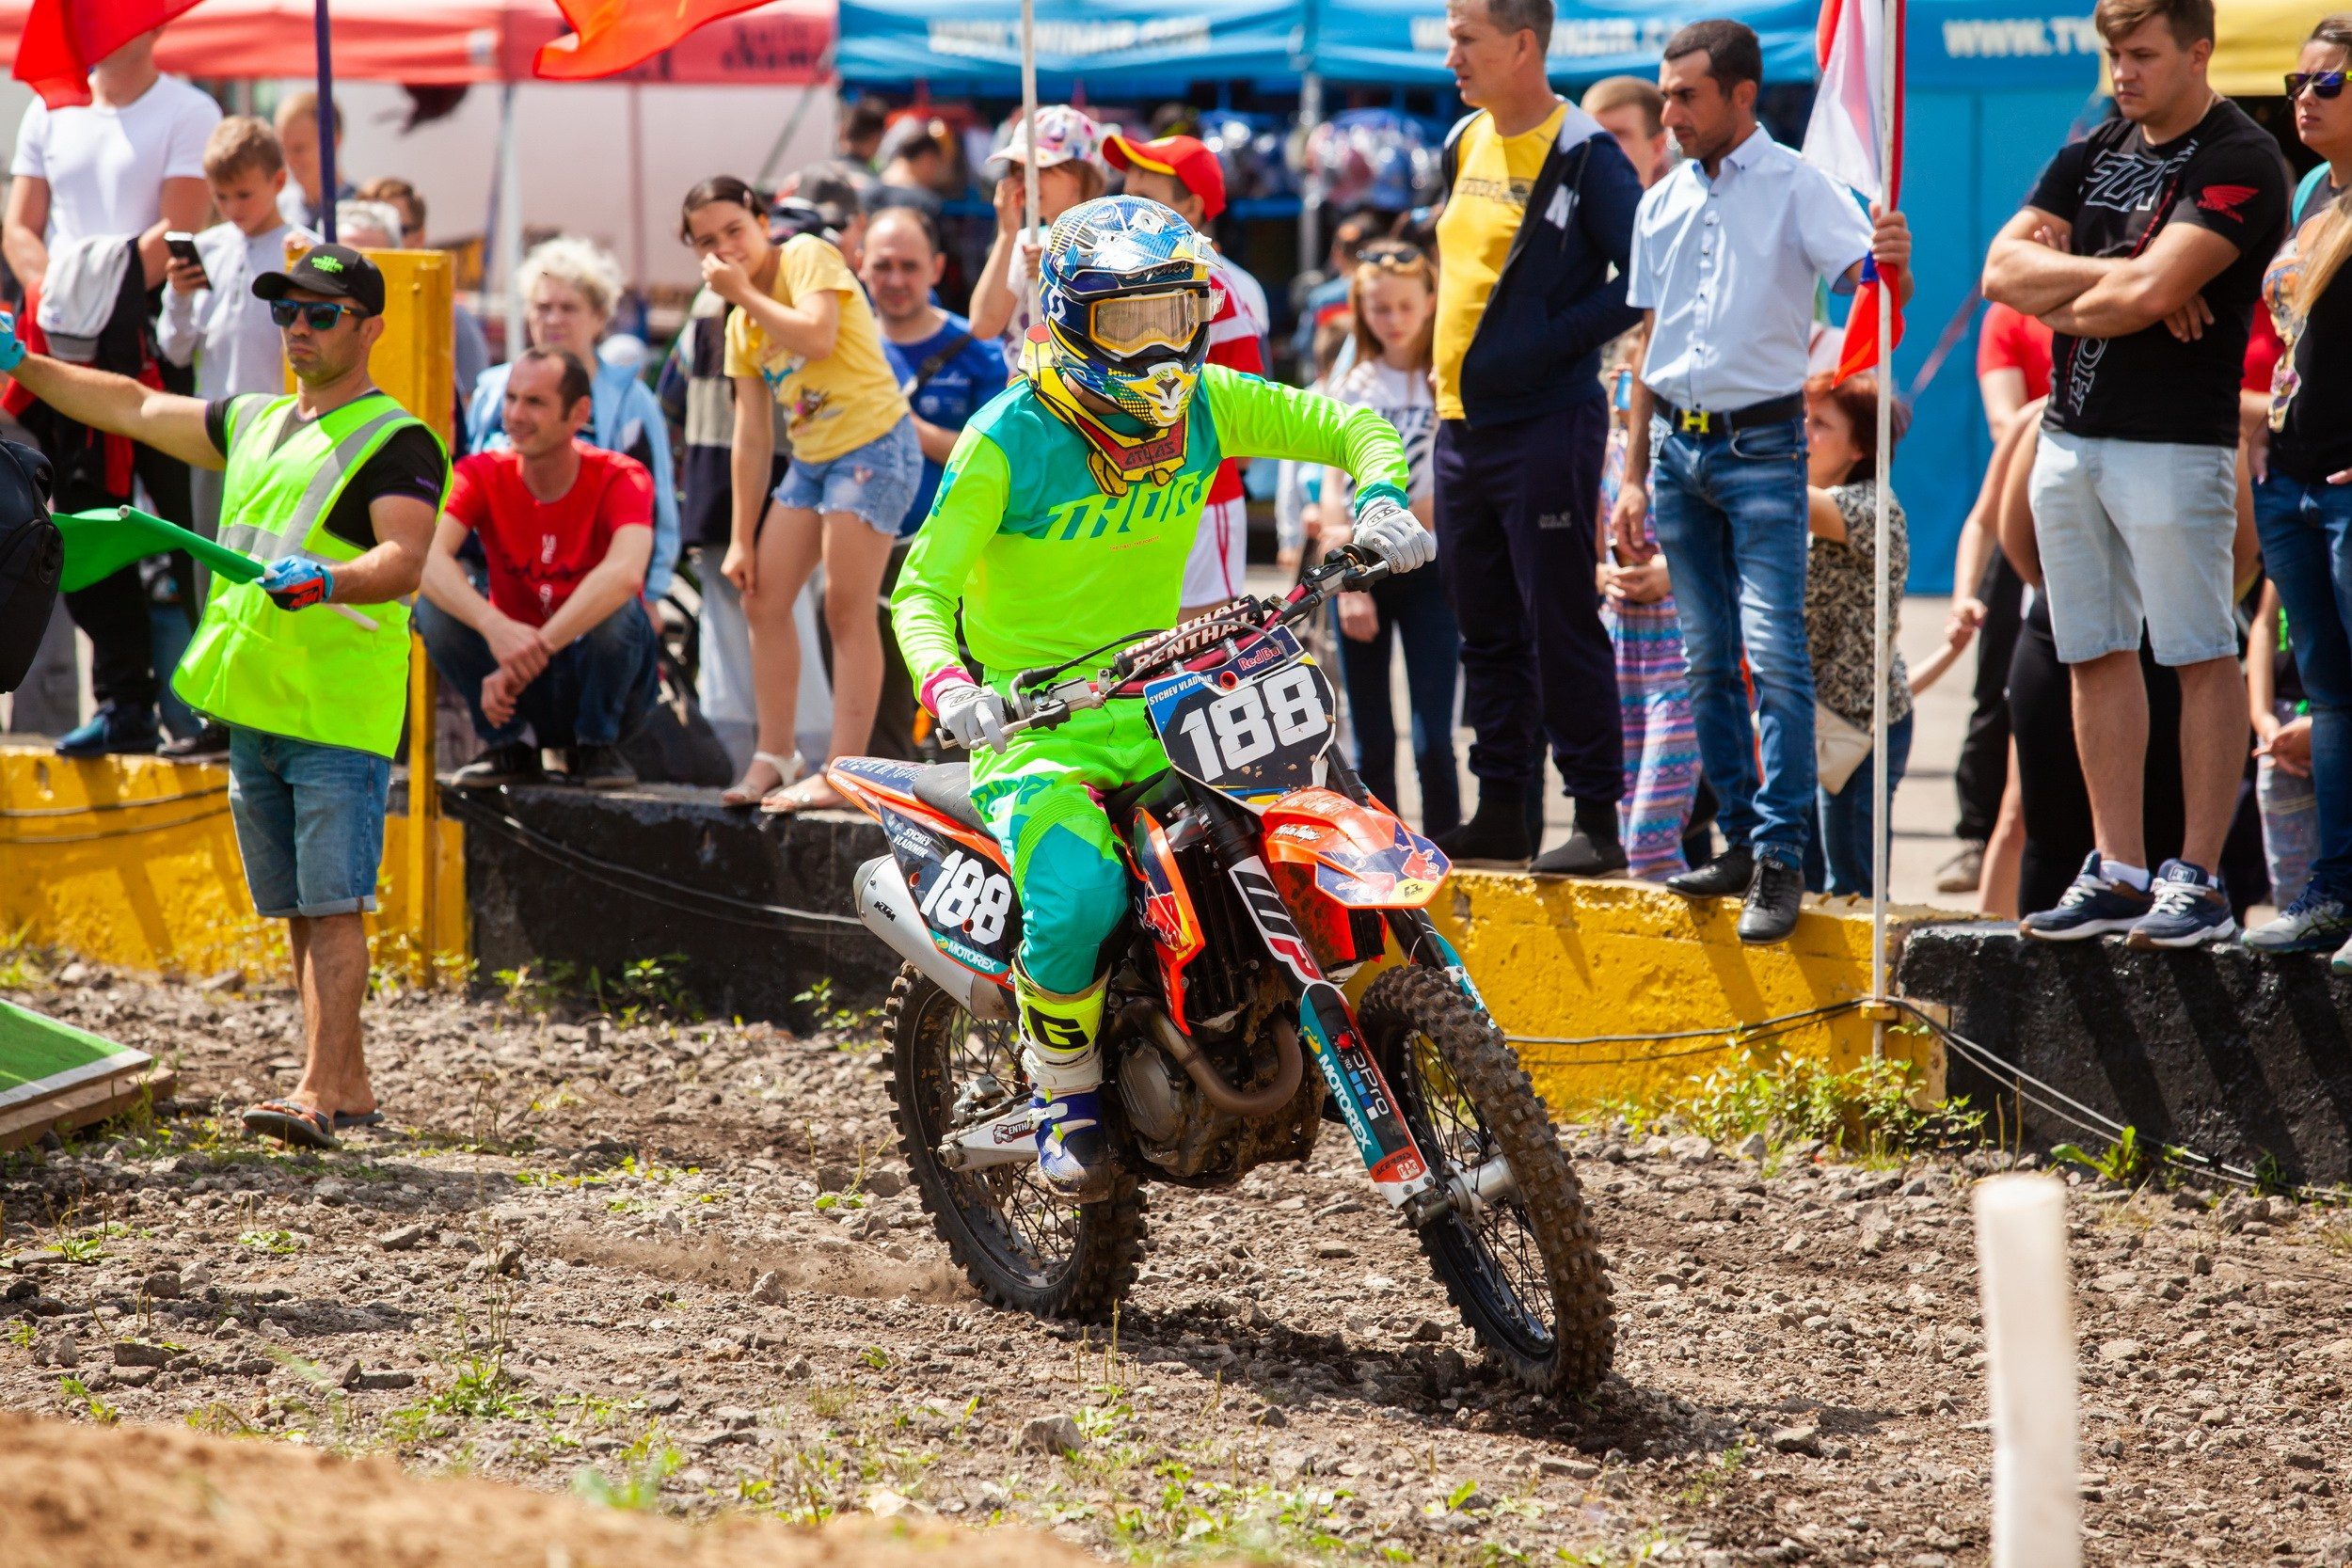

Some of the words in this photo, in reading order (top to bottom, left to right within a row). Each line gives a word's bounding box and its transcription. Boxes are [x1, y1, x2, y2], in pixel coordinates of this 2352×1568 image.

[1942, 16, 2100, 58] WWW.TW
[1124, 440, 1176, 466] ATLAS
[1124, 599, 1249, 657] RENTHAL
[1238, 649, 1263, 672] Red
[1149, 685, 1178, 706] SYCHEV
[1179, 665, 1328, 783] 188
[892, 834, 930, 858] VLADIMIR
[902, 827, 933, 847] SYCHEV
[919, 849, 1012, 945] 188
[874, 900, 897, 922] KTM
[947, 940, 997, 973] MOTOREX
[1348, 1033, 1390, 1116] oPro
[1318, 1053, 1373, 1153] MOTOREX
[993, 1119, 1031, 1144] RENTH
[1375, 1151, 1412, 1177] ACERBIS
[1398, 1159, 1420, 1180] PPG
